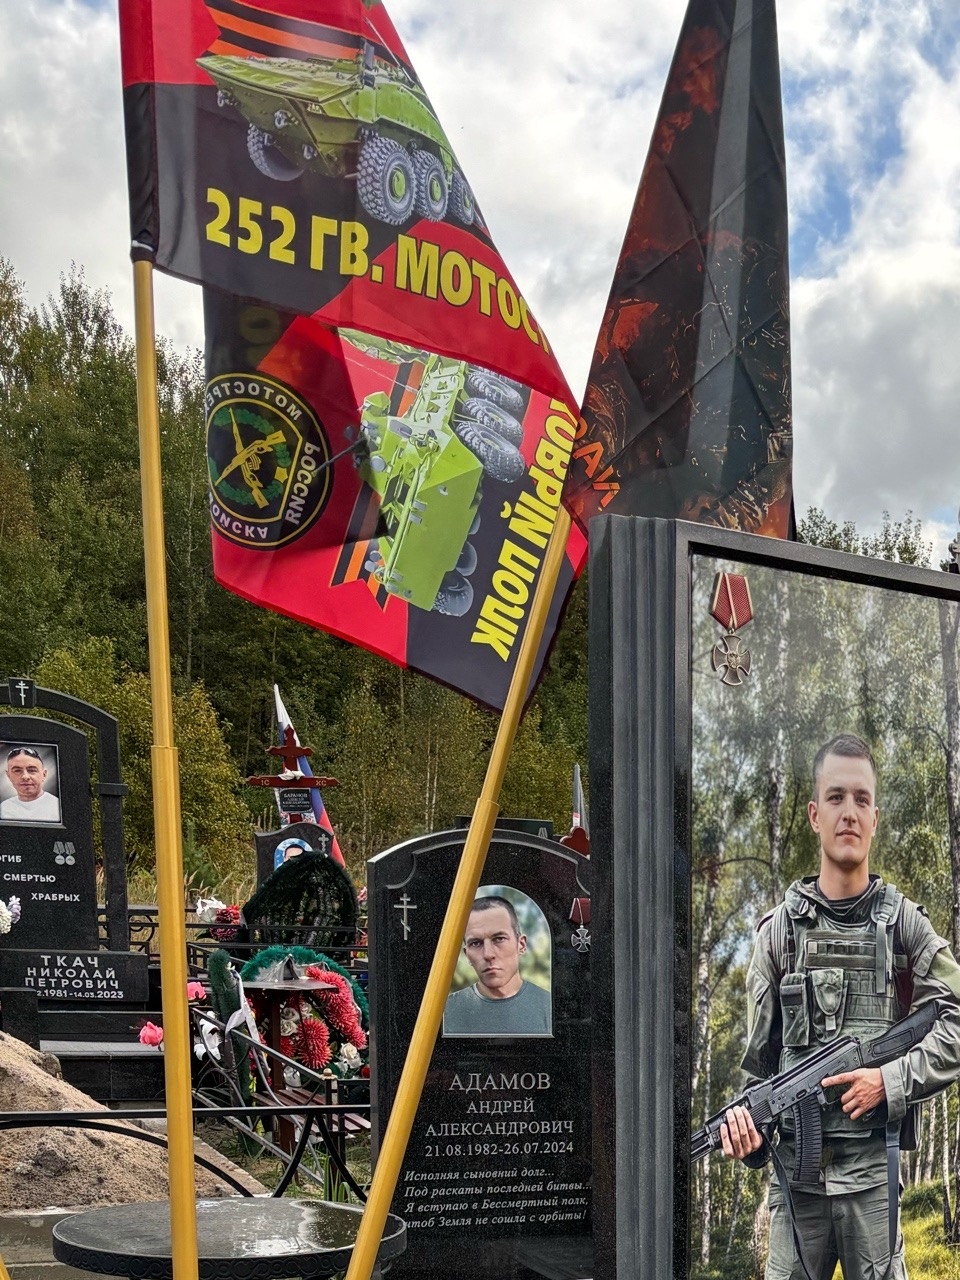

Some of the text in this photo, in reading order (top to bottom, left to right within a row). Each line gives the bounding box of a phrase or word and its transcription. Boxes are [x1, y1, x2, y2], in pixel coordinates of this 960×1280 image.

[205, 187, 296, 265] 252
[309, 215, 384, 284] ГВ.
[3, 873, 56, 883] СМЕРТЬЮ
[31, 892, 81, 902] ХРАБРЫХ
[40, 954, 99, 968] ТКАЧ
[27, 967, 116, 979] НИКОЛАЙ
[25, 977, 119, 989] ПЕТРОВИЧ
[448, 1072, 551, 1094] АДАМОВ
[466, 1096, 535, 1116] АНДРЕЙ
[425, 1120, 575, 1137] АЛЕКСАНДРОВИЧ
[425, 1141, 574, 1157] 21.08.1982-26.07.2024
[404, 1167, 555, 1182] Исполняя сыновний долг...
[404, 1180, 592, 1199] Под раскаты последней битвы...
[404, 1196, 589, 1214] Я вступаю в Бессмертный полк,
[438, 1216, 472, 1227] Земля
[475, 1216, 488, 1225] не
[491, 1213, 526, 1224] сошла
[529, 1214, 535, 1222] с
[538, 1210, 587, 1223] орбиты!
